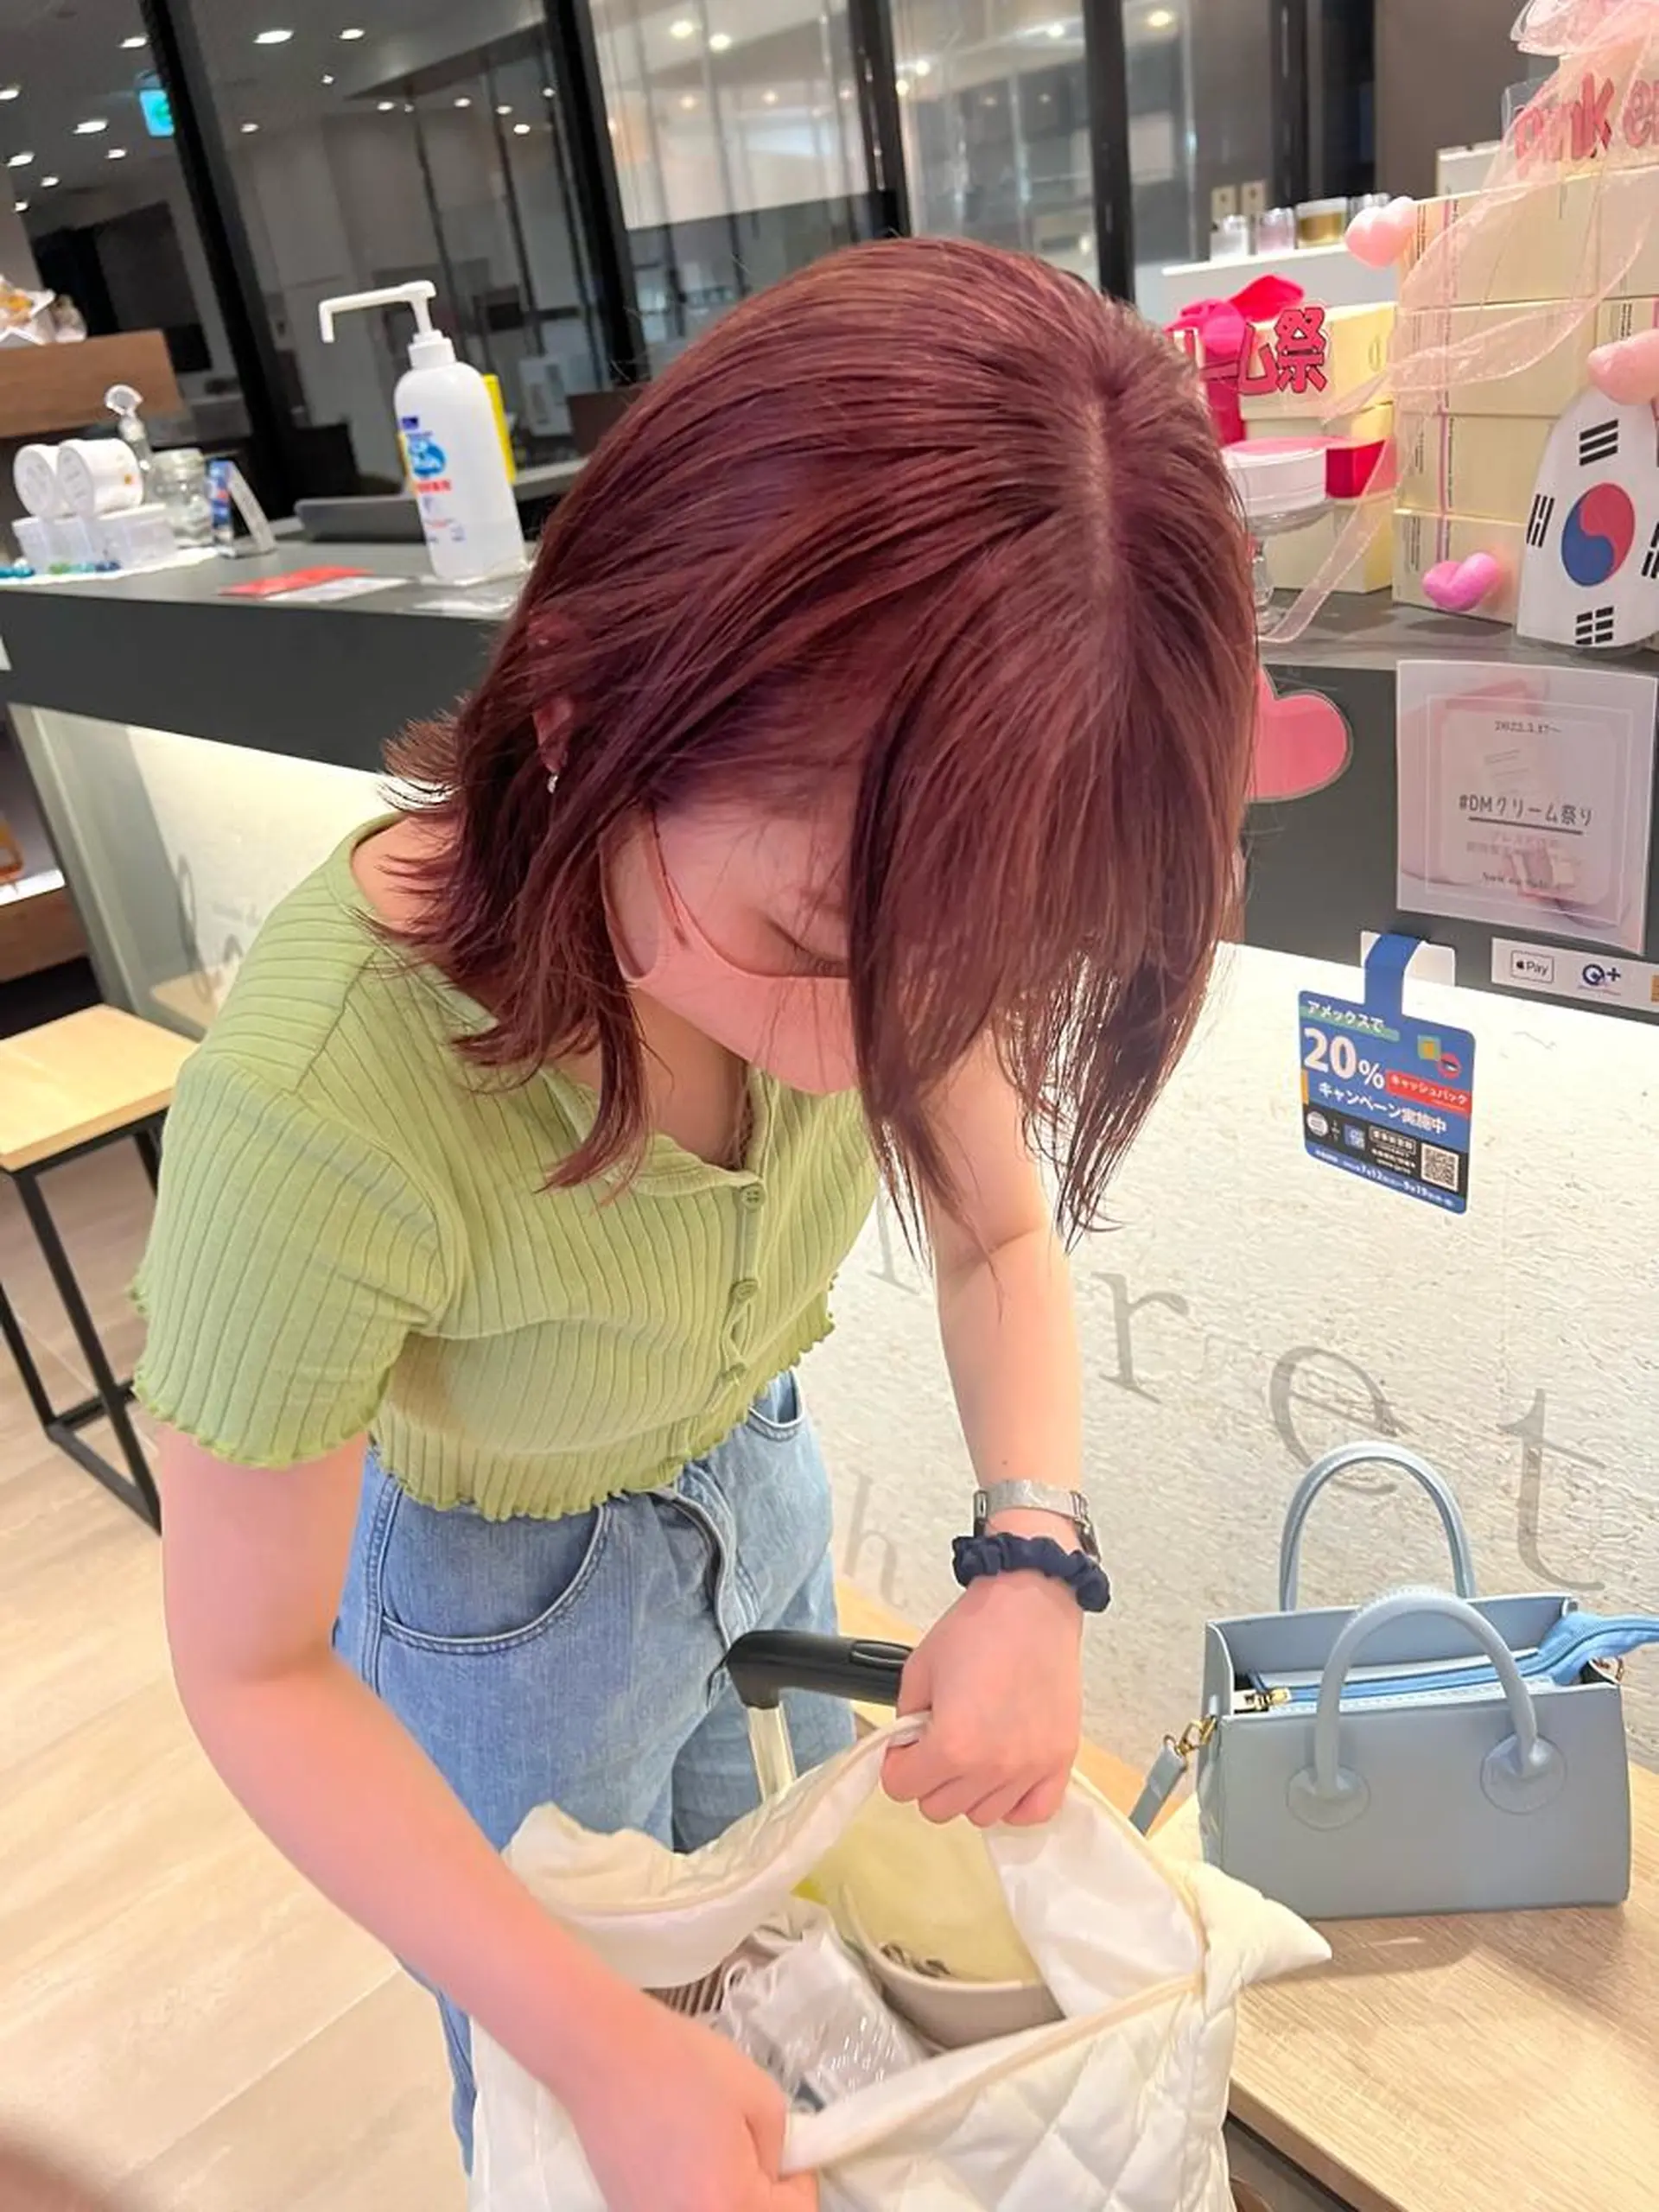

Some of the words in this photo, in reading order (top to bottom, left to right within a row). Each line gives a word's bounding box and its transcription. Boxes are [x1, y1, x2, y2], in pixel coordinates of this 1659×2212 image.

[1526, 961, 1549, 977] Pay
[1307, 1000, 1386, 1033] アメックスで
[1303, 1027, 1386, 1090] 20%
